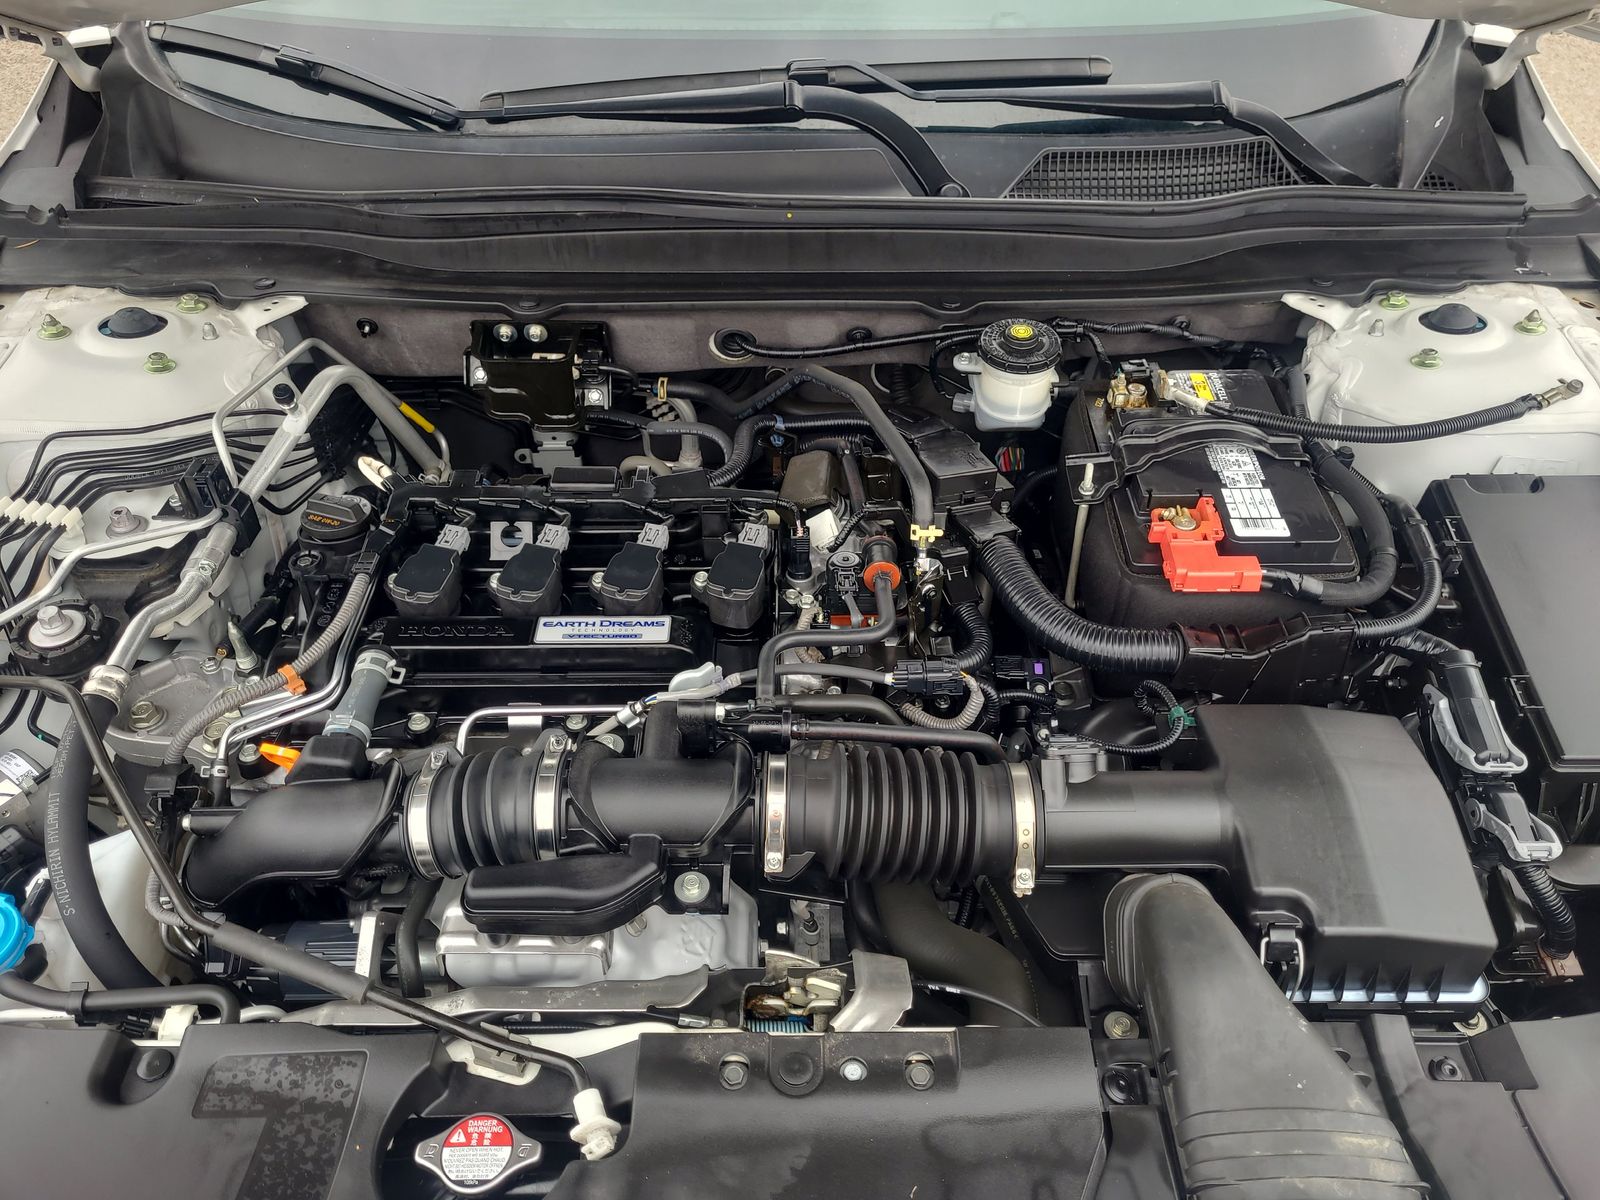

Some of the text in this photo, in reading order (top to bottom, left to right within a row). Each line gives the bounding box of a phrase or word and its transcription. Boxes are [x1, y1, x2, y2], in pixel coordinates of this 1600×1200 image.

[1208, 372, 1228, 401] DURACELL
[542, 619, 666, 628] EARTH DREAMS
[398, 625, 515, 637] HONDA
[468, 1119, 498, 1127] DANGER
